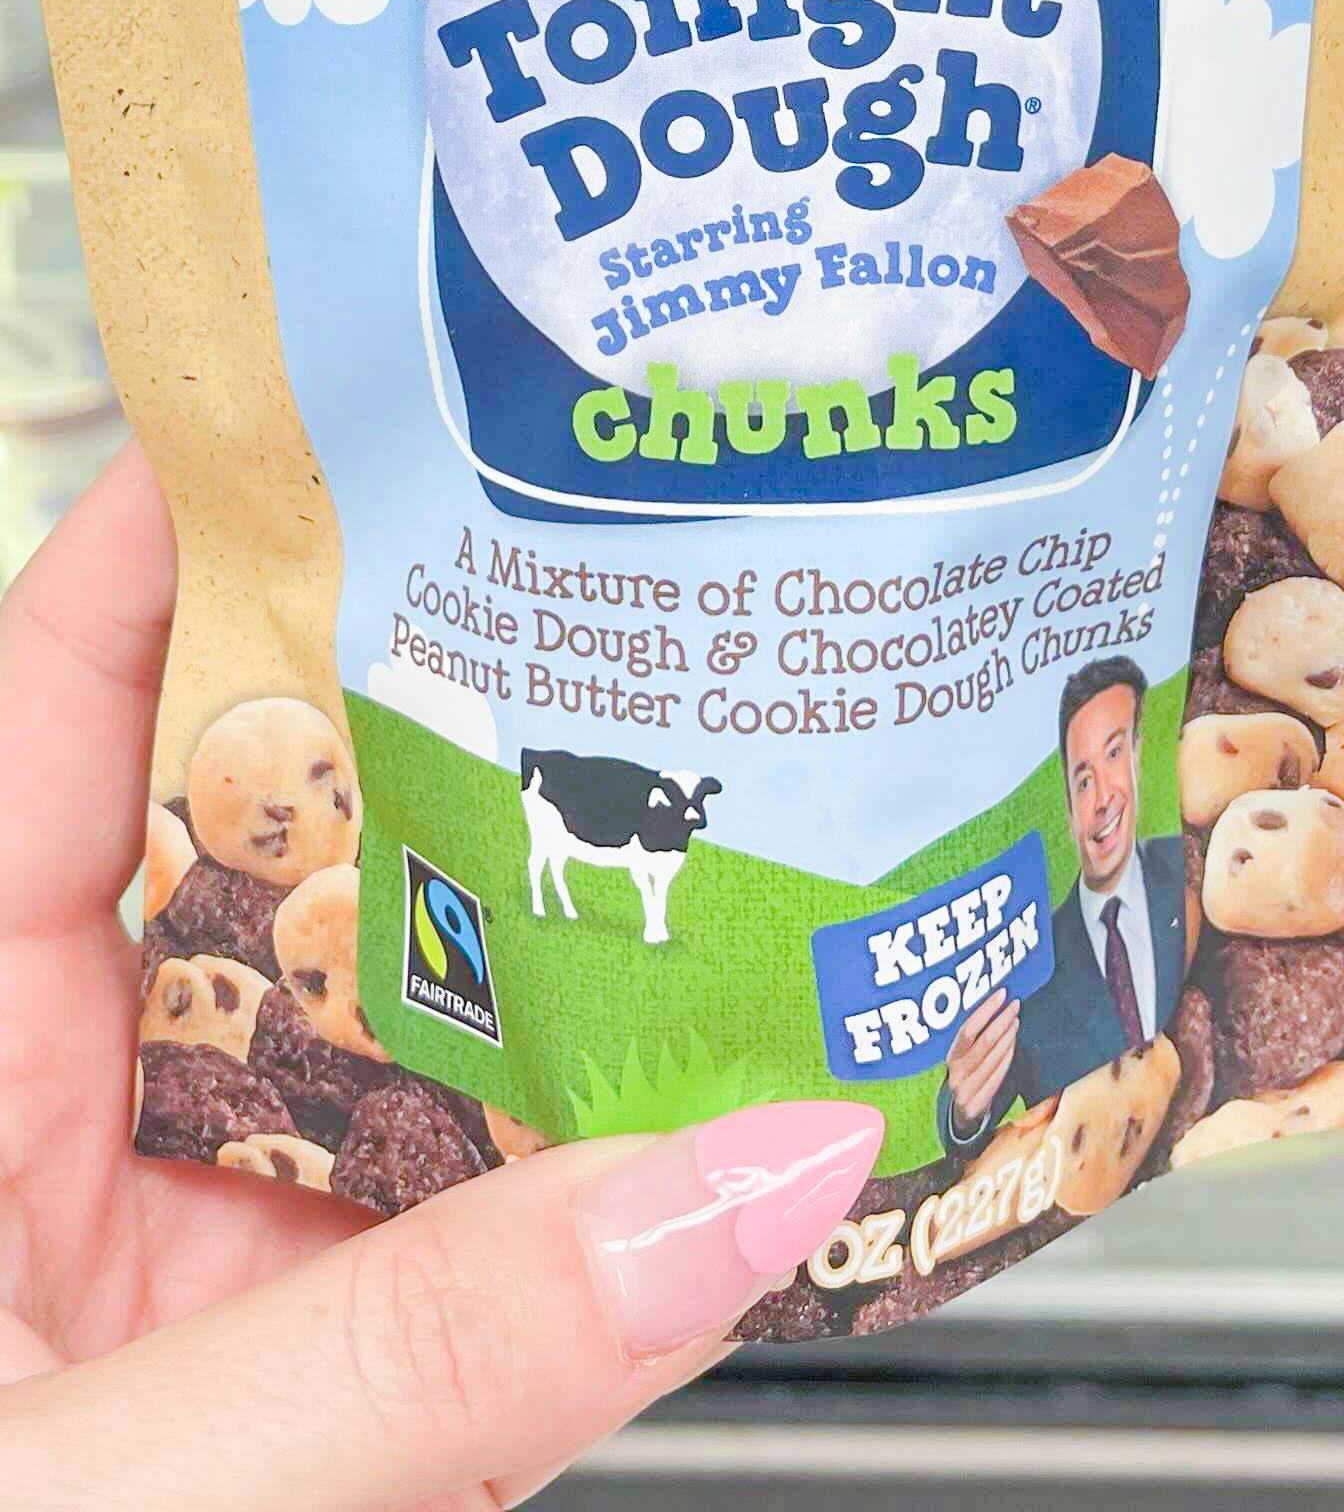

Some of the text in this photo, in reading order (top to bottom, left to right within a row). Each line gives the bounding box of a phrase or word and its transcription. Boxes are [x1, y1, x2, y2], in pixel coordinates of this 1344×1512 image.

[591, 240, 998, 356] Jimmy Fallon
[599, 196, 813, 291] Starring
[572, 354, 1018, 465] chunks
[406, 551, 1167, 678] Cookie Dough & Chocolatey Coated
[455, 526, 1112, 617] A Mixture of Chocolate Chip
[391, 607, 1156, 736] Peanut Butter Cookie Dough Chunks
[844, 901, 1039, 1064] FROZEN
[867, 874, 1012, 987] KEEP
[410, 974, 497, 1032] FAIRTRADE
[910, 1133, 1063, 1276] (227g)
